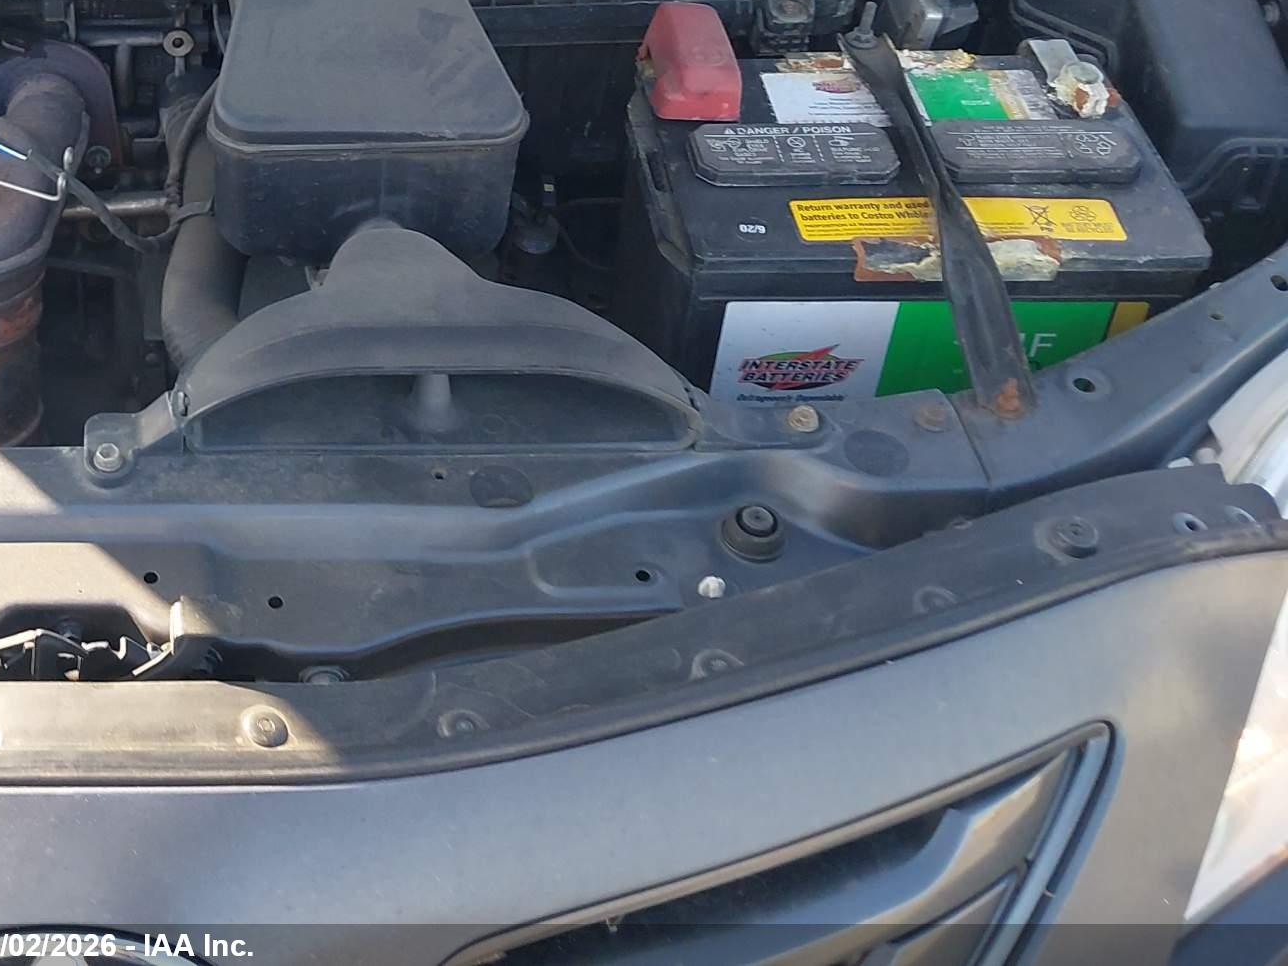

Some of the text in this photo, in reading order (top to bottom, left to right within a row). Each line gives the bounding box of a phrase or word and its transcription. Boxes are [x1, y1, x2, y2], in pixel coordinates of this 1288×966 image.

[737, 126, 790, 135] DANGER
[803, 125, 852, 135] POISON
[796, 200, 929, 213] Return warranty and used
[800, 212, 847, 222] batteries
[848, 212, 860, 220] to
[861, 211, 895, 220] Costco
[741, 359, 859, 371] INTERSTATE
[742, 372, 846, 382] BATTERIES
